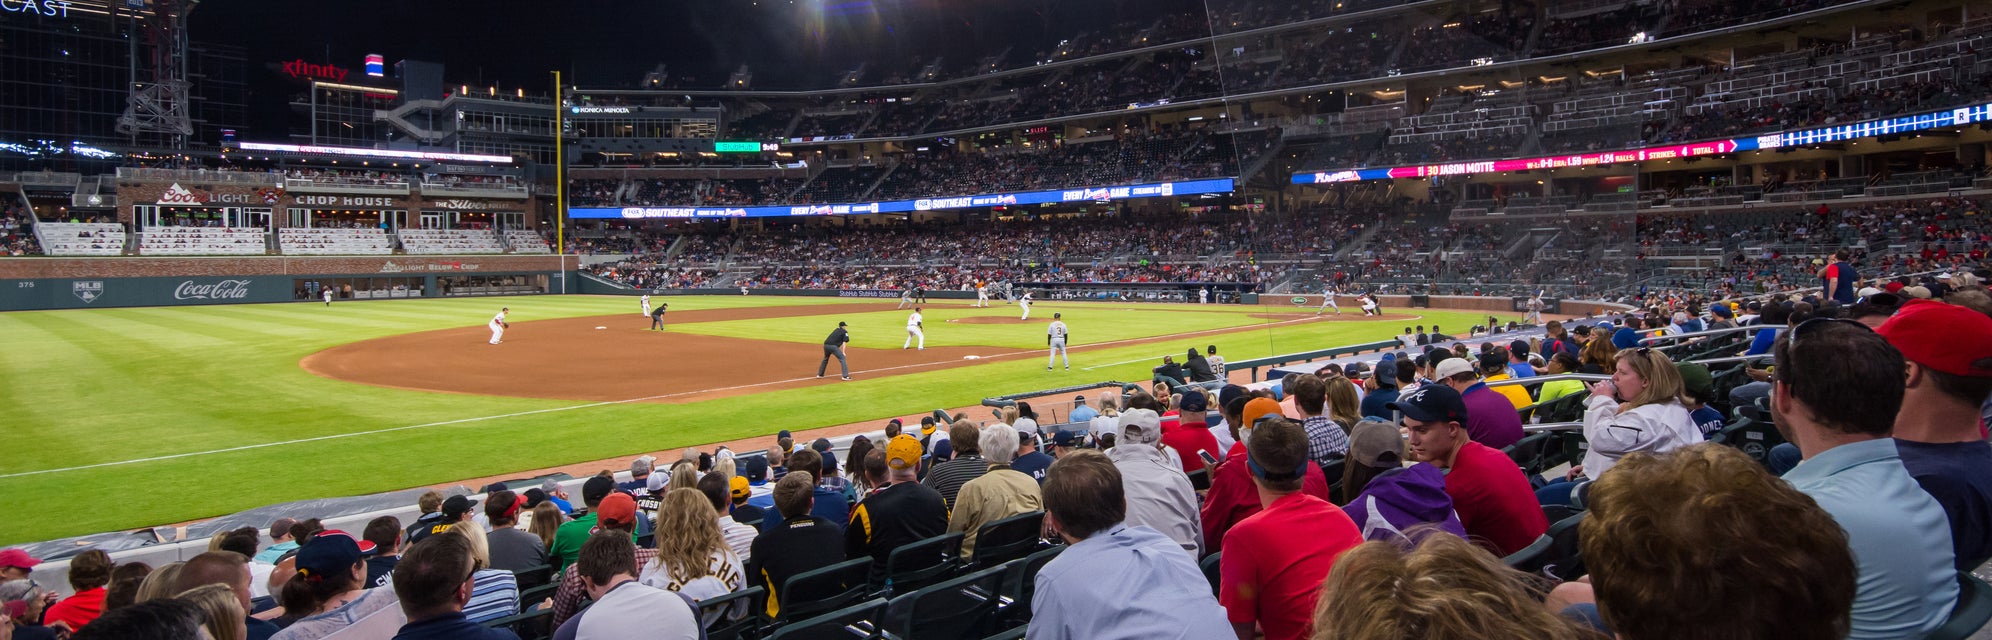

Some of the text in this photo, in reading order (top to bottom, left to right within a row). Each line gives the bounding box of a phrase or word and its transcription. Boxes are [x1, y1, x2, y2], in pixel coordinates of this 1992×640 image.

[281, 59, 349, 82] xfinity
[722, 143, 754, 151] StubHub
[762, 143, 778, 151] 9:49
[1600, 153, 1614, 164] 1.24
[1681, 146, 1688, 157] 4
[1693, 147, 1714, 156] TOTAL:
[1427, 165, 1438, 176] 30
[1440, 164, 1465, 176] JASON
[1467, 161, 1495, 173] MOTTE
[162, 188, 250, 203] Coors LIGHT
[1063, 190, 1084, 201] EVERY
[1110, 187, 1130, 198] GAME
[295, 195, 393, 207] CHOP HOUSE
[448, 199, 487, 210] Silver
[932, 197, 972, 209] SOUTHEAST
[645, 208, 695, 217] SOUTHEAST
[791, 206, 810, 215] EVERY
[833, 205, 850, 214] GAME
[174, 279, 252, 300] Coca-Cola
[1210, 363, 1224, 375] 36
